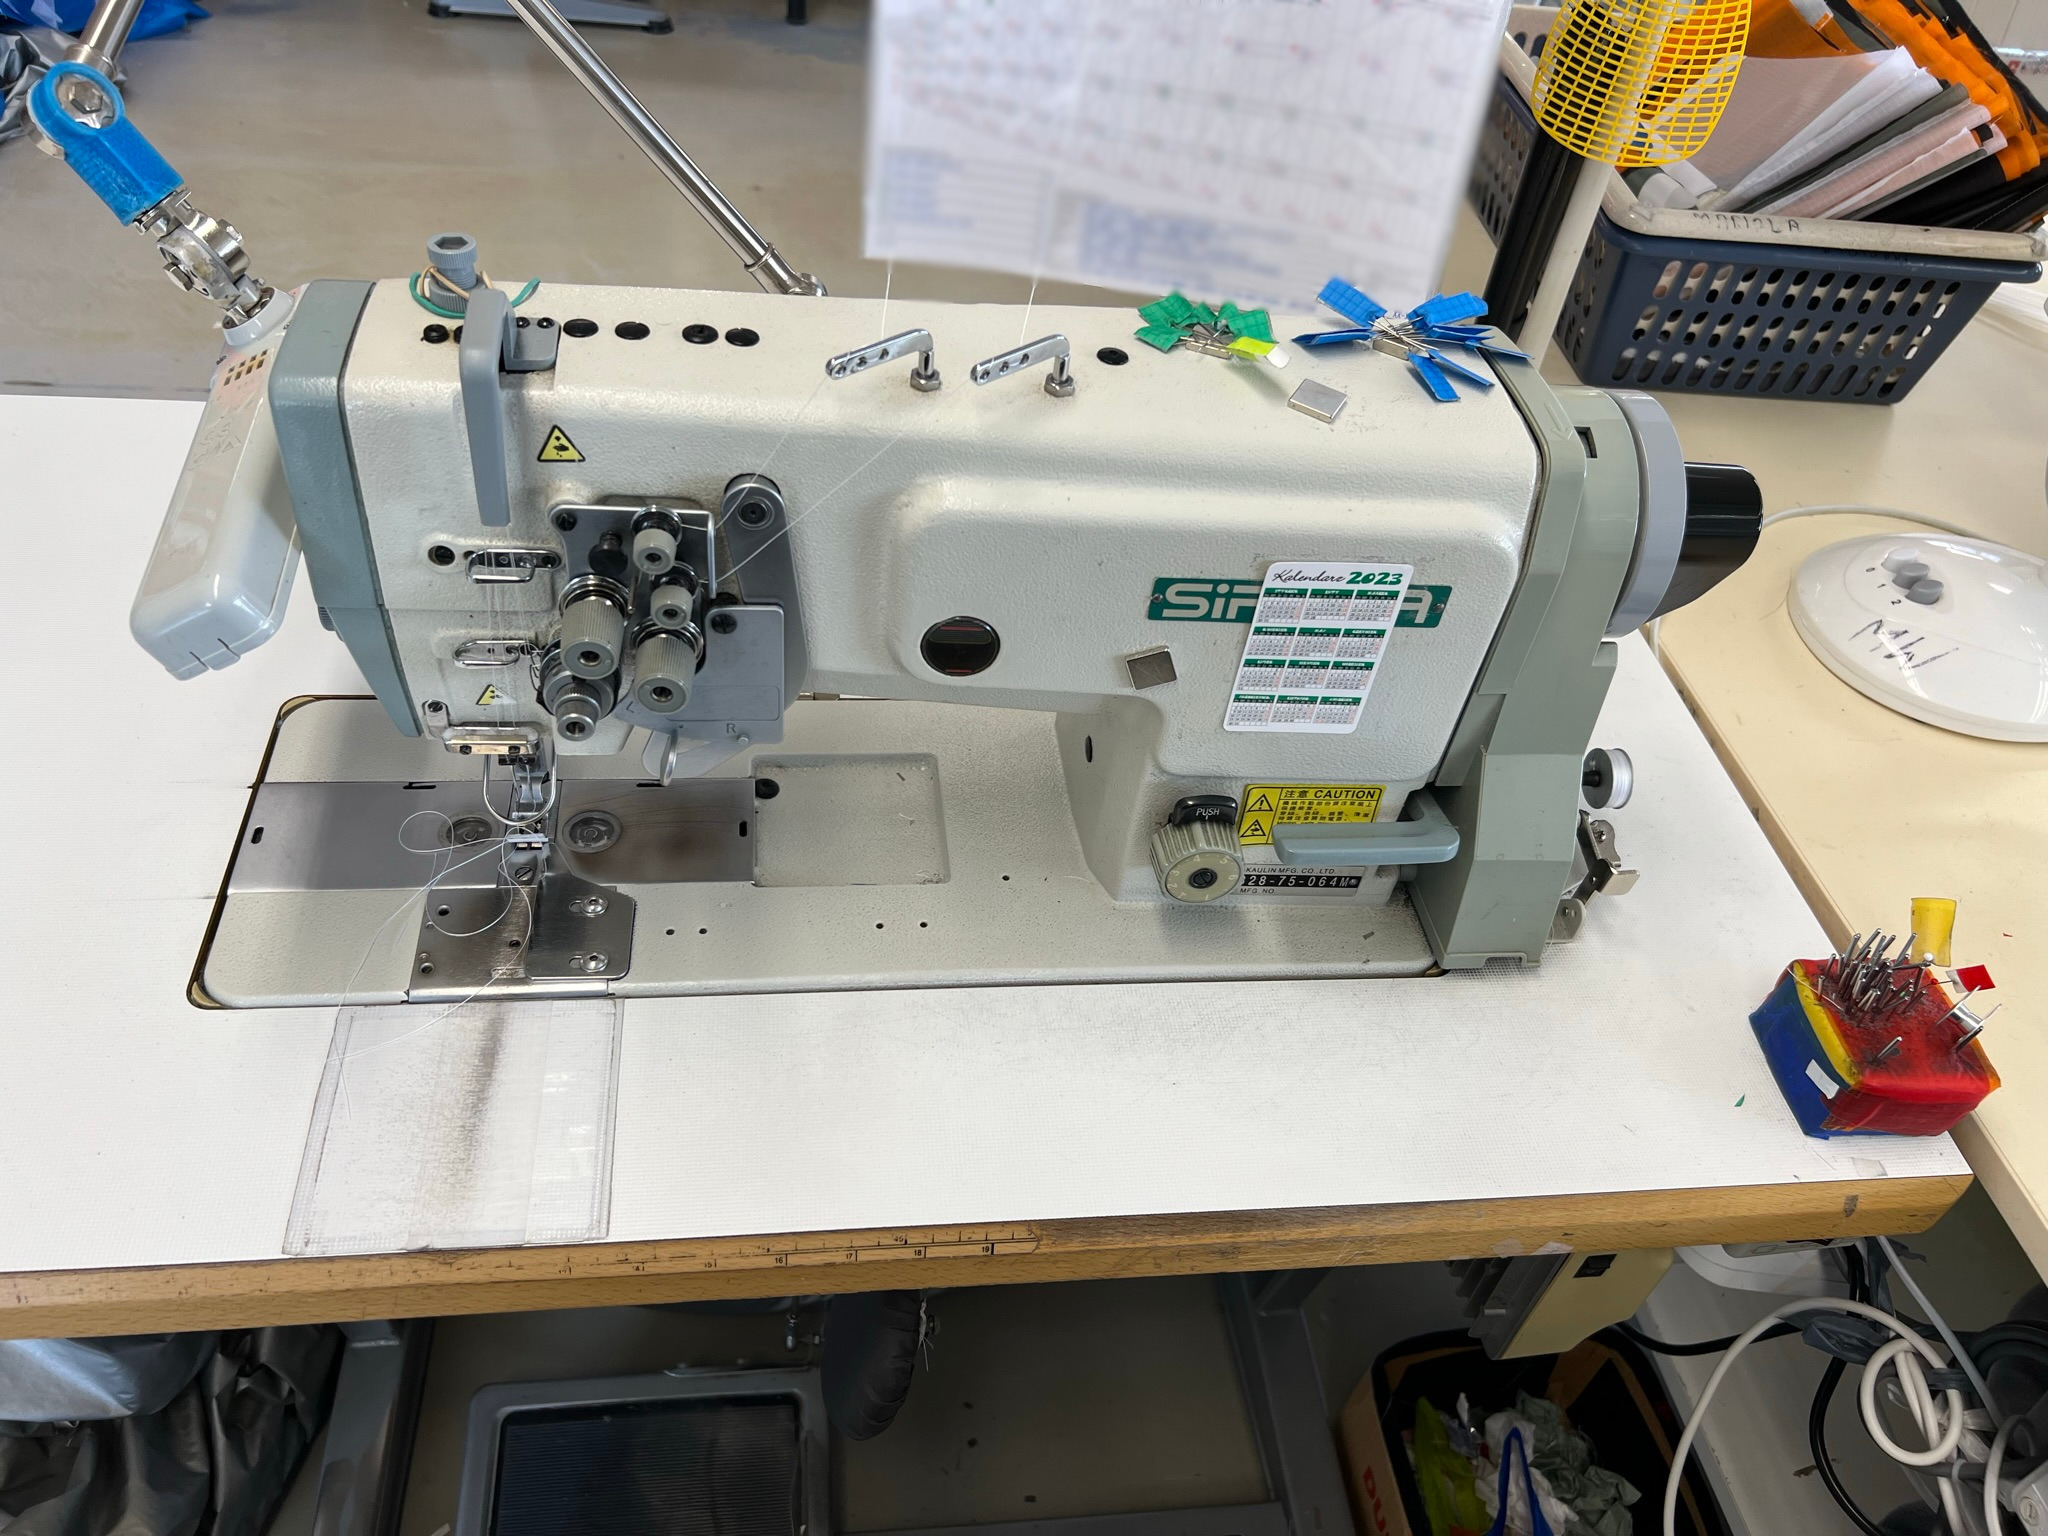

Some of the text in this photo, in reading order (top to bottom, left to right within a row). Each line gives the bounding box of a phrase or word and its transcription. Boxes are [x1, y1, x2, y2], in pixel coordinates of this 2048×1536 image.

[1346, 571, 1403, 585] 2023
[626, 701, 635, 713] L
[726, 723, 737, 734] R
[1314, 790, 1376, 799] CAUTION
[1196, 808, 1220, 816] PUSH
[1220, 856, 1230, 864] 5
